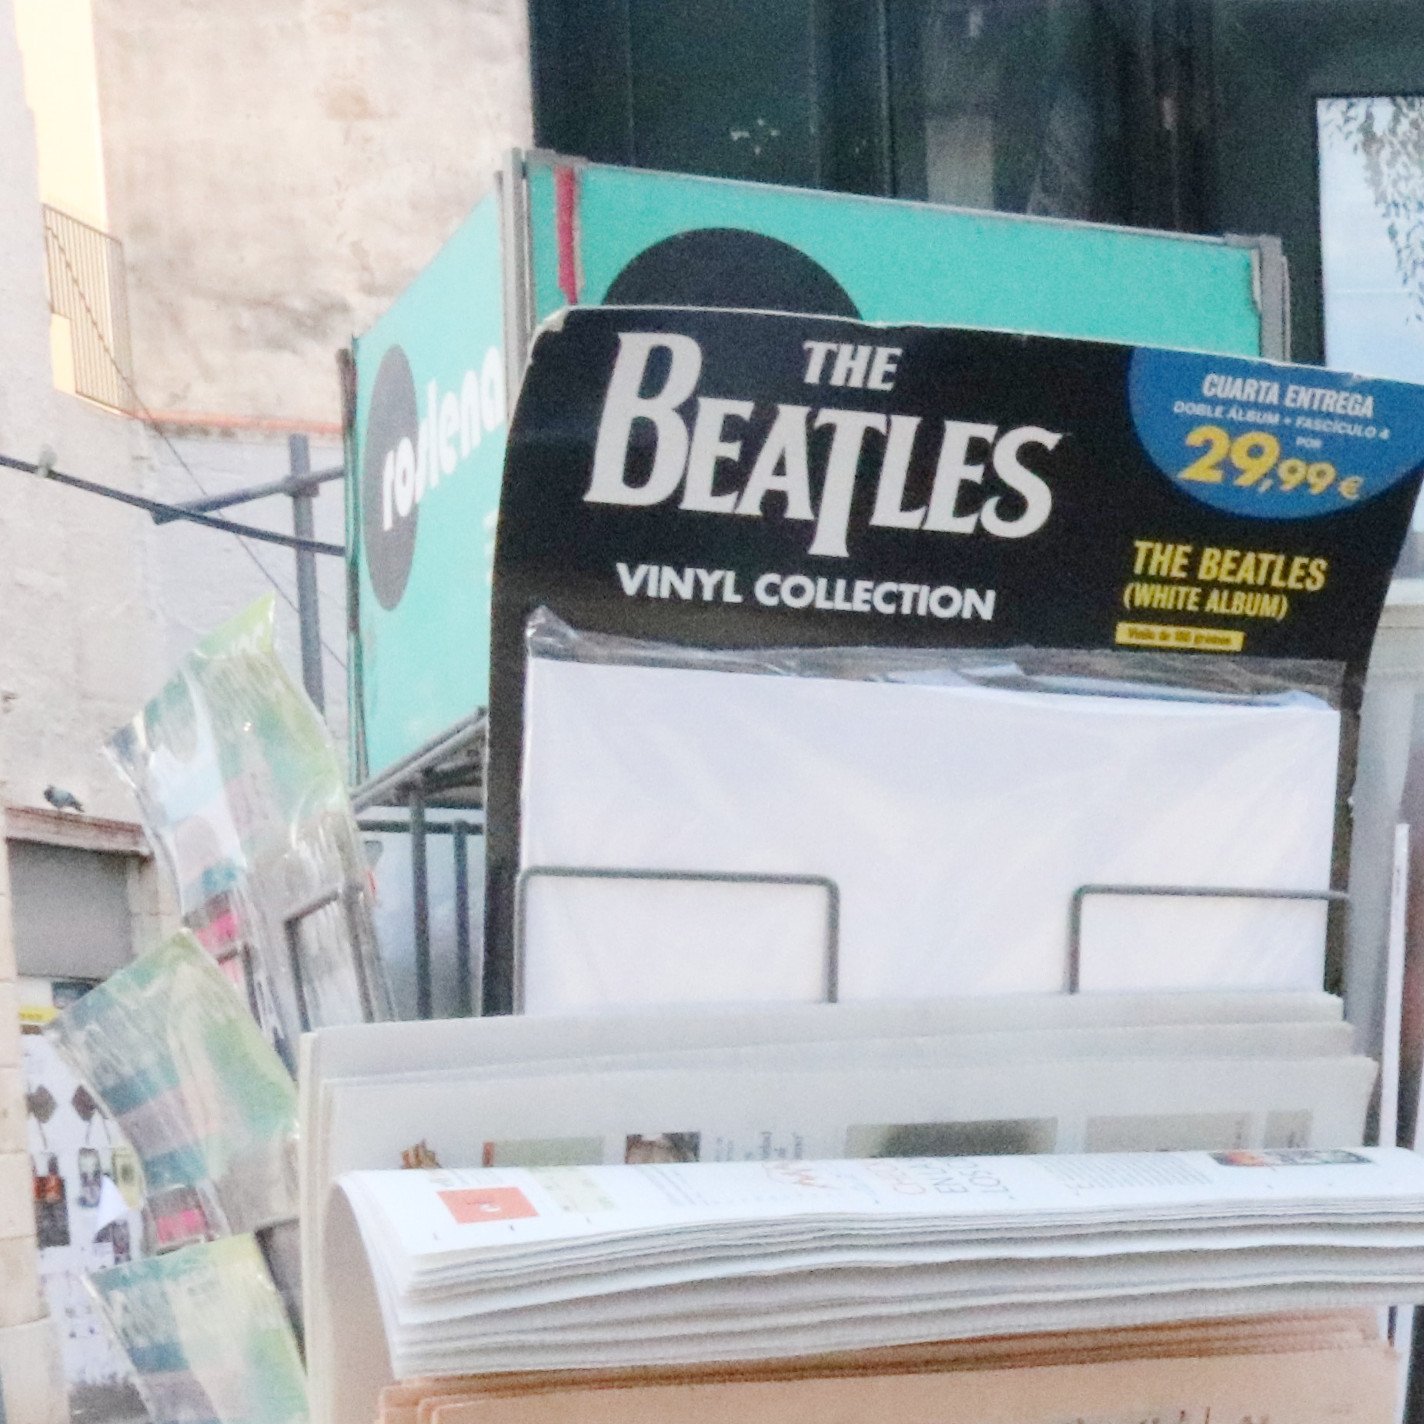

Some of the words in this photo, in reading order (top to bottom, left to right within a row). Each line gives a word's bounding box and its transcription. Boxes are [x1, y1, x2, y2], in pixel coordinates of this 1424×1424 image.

[803, 340, 903, 392] THE
[1203, 372, 1279, 406] CUARTA
[1285, 384, 1374, 418] ENTREGA
[584, 331, 1071, 559] BEATLES
[1177, 425, 1337, 494] 29,99
[615, 561, 743, 610] VINYL
[754, 572, 996, 622] COLLECTION
[1133, 540, 1193, 579] THE
[1199, 547, 1328, 592] BEATLES
[1123, 581, 1202, 612] (WHITE
[1204, 588, 1289, 622] ALBUM)
